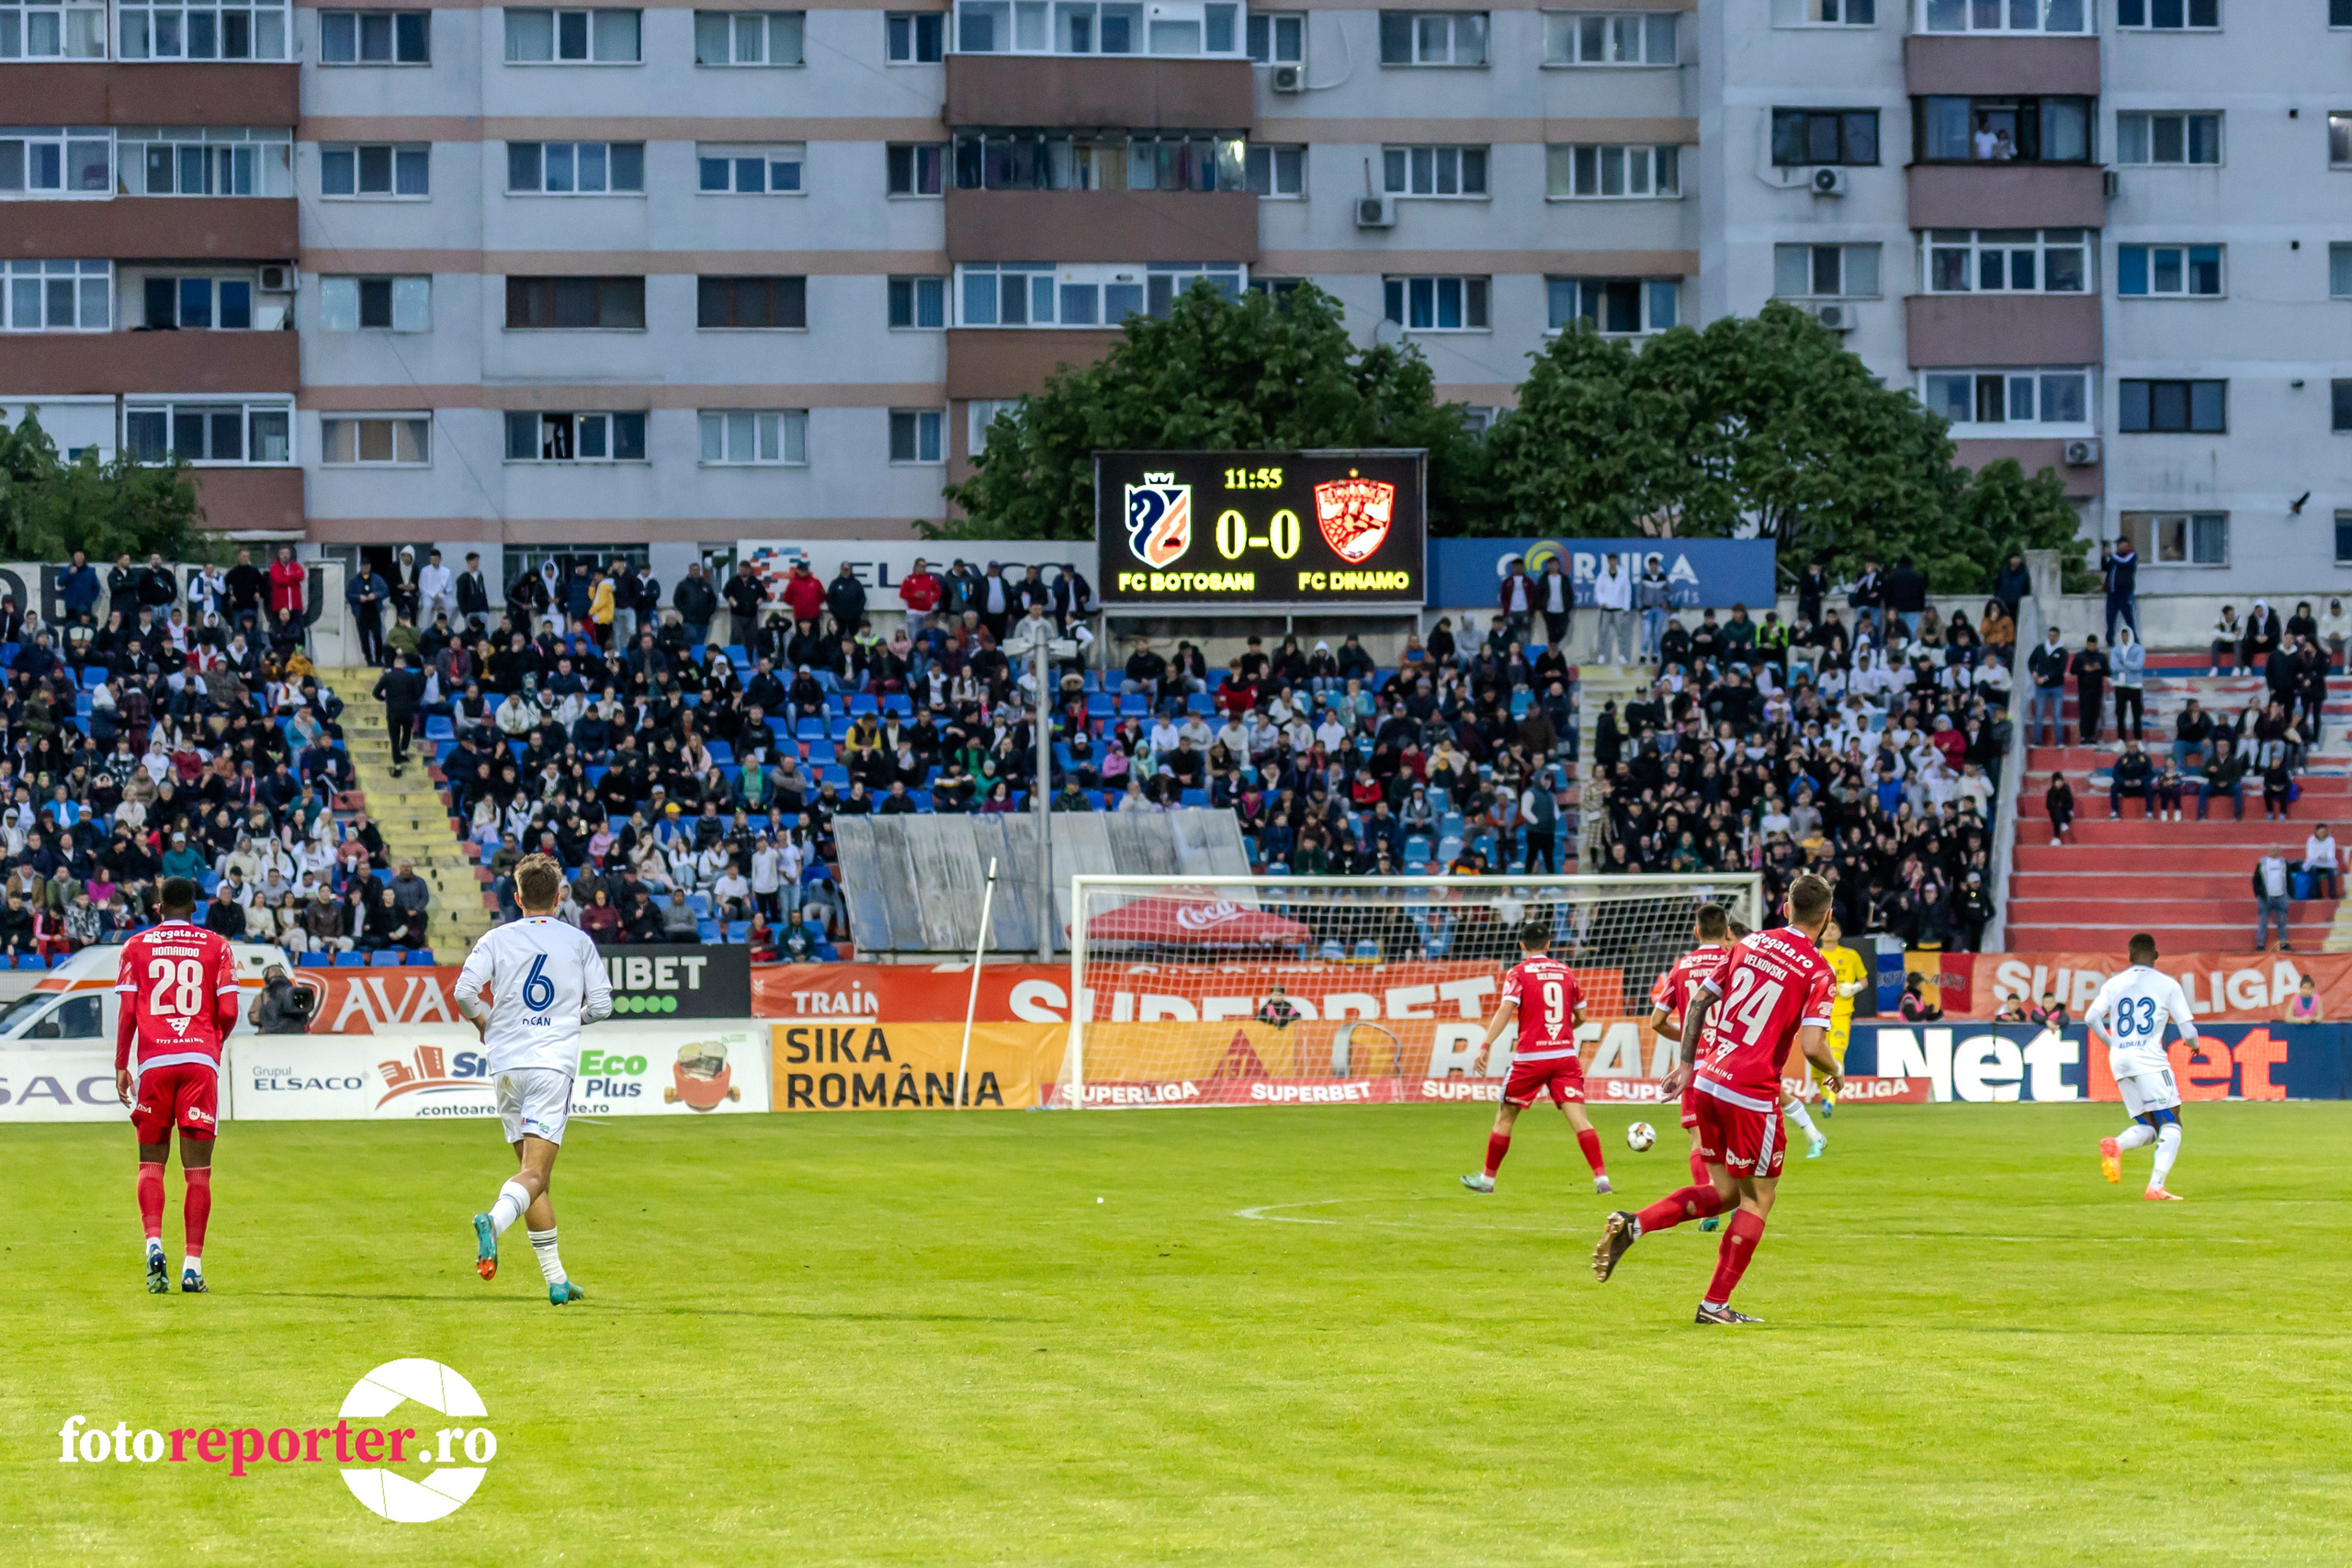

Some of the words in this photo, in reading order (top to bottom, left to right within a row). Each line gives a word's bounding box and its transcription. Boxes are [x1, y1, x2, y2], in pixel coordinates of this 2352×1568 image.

[1224, 468, 1283, 490] 11:55
[1216, 509, 1302, 559] 0-0
[1118, 572, 1147, 592] FC
[1150, 572, 1256, 592] BOTOSANI
[1298, 571, 1326, 591] FC
[1329, 571, 1410, 591] DINAMO
[153, 930, 208, 939] Regata.ro
[152, 946, 199, 957] HOMAWOO
[1753, 932, 1814, 969] Regata.ro
[1744, 953, 1789, 982] VELKOVSKI
[148, 958, 205, 1016] 28
[523, 953, 556, 1011] 6
[1993, 960, 2302, 1014] SUPLIGA
[1543, 981, 1565, 1024] 9
[1718, 966, 1784, 1046] 24
[2117, 997, 2156, 1038] 83
[786, 1027, 892, 1065] SIKA
[253, 1066, 292, 1078] Grupul
[579, 1050, 648, 1077] Eco
[254, 1077, 362, 1091] ELSACO
[584, 1078, 642, 1098] Plus
[787, 1063, 1004, 1109] ROMÂNIA
[1062, 1081, 1200, 1103] SUPERLIGA
[1251, 1081, 1371, 1102] SUPERBET
